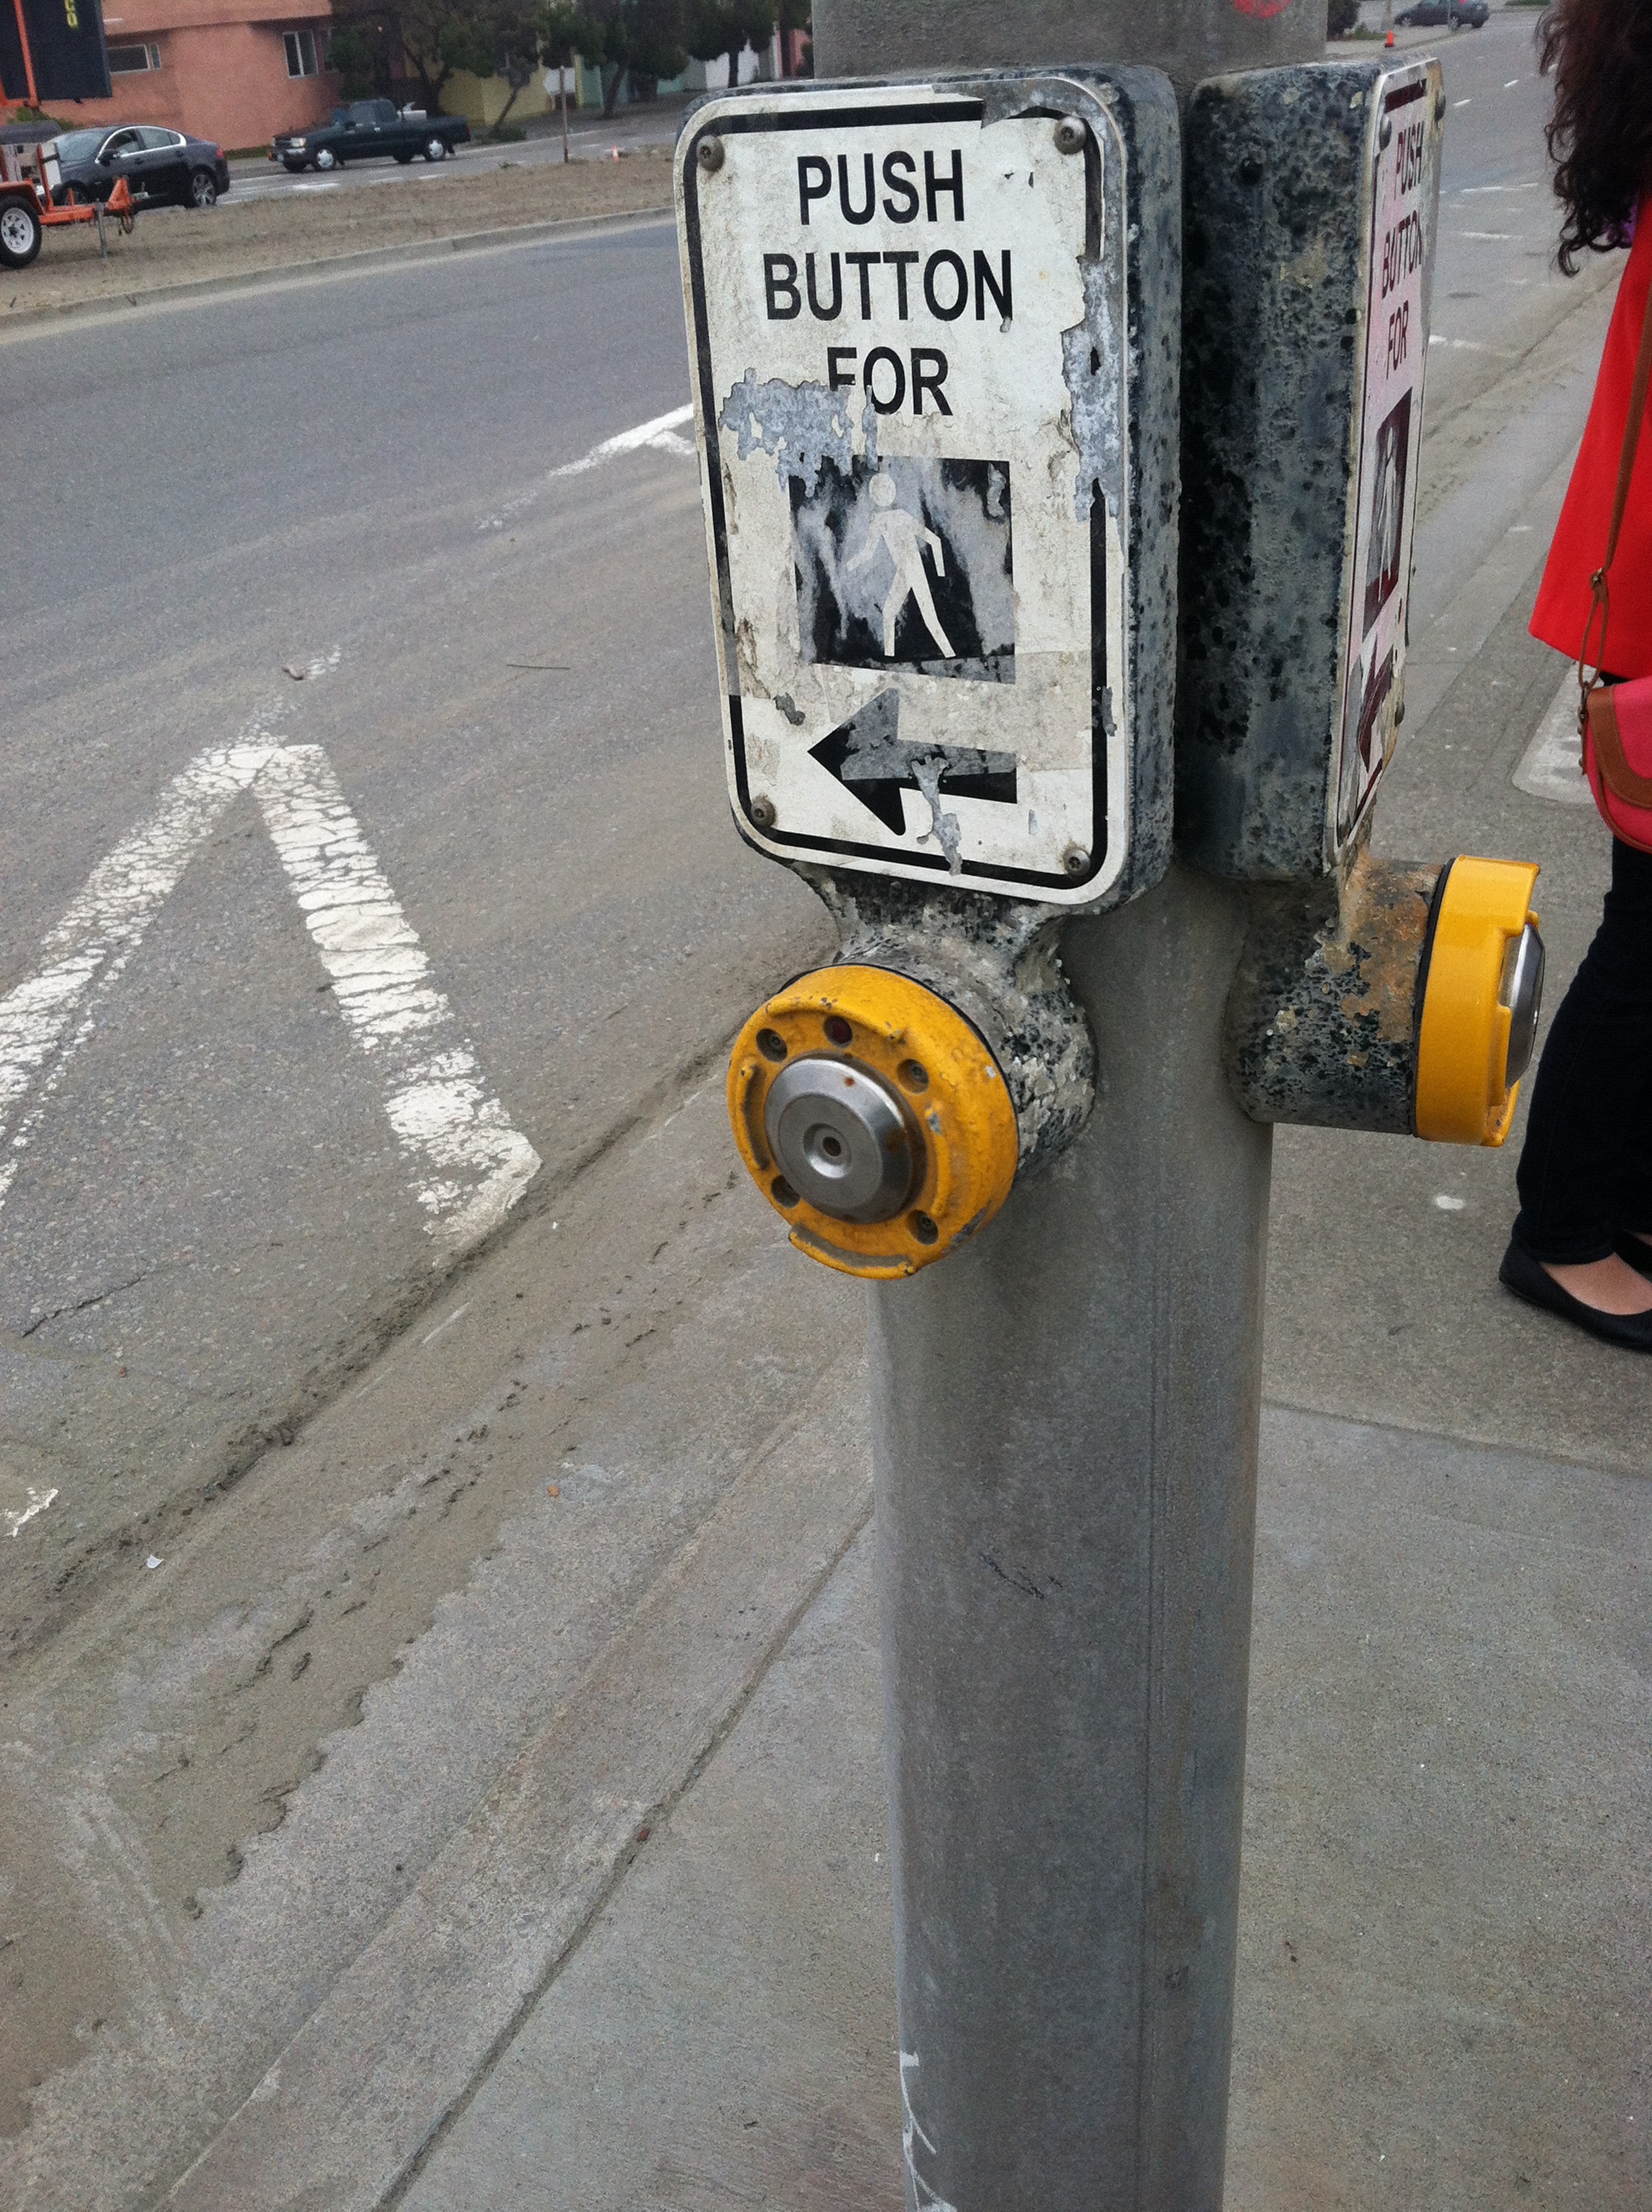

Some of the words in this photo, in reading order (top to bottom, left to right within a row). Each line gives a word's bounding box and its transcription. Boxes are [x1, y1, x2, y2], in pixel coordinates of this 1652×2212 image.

[797, 149, 965, 225] PUSH
[1393, 120, 1424, 201] PUSH
[763, 250, 1014, 321] BUTTON
[1382, 207, 1422, 300] BUTTON
[1386, 300, 1409, 380] FOR
[827, 346, 954, 416] FOR
